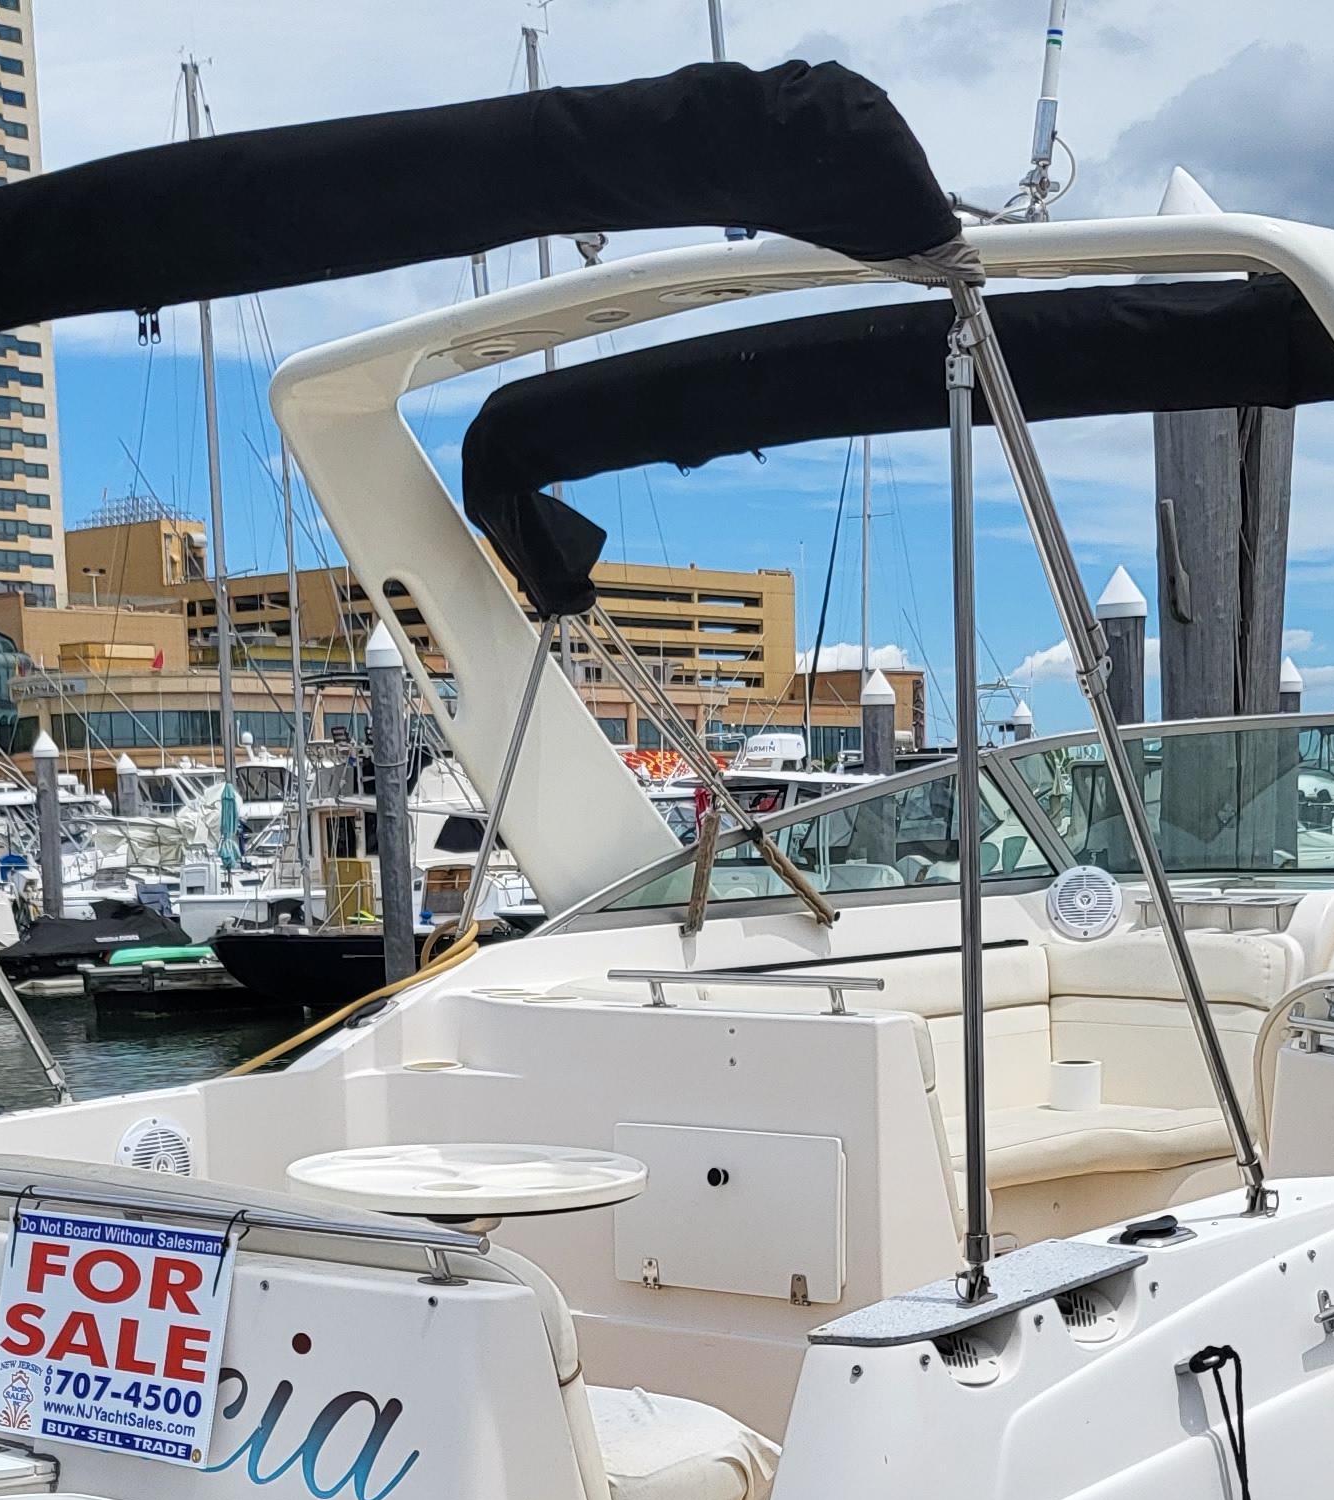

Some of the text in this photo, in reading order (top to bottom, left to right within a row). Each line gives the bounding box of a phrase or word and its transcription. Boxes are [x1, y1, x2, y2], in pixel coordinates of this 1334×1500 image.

[20, 1216, 222, 1254] Do Not Board Without Salesman
[26, 1240, 204, 1316] FOR
[0, 1302, 211, 1384] SALE
[0, 1360, 43, 1376] NEW JERSEY
[5, 1391, 31, 1401] SALES
[55, 1369, 202, 1418] 707-4500
[43, 1400, 196, 1437] www.NJYachtSales.com
[46, 1421, 187, 1457] BUY SELL TRADE
